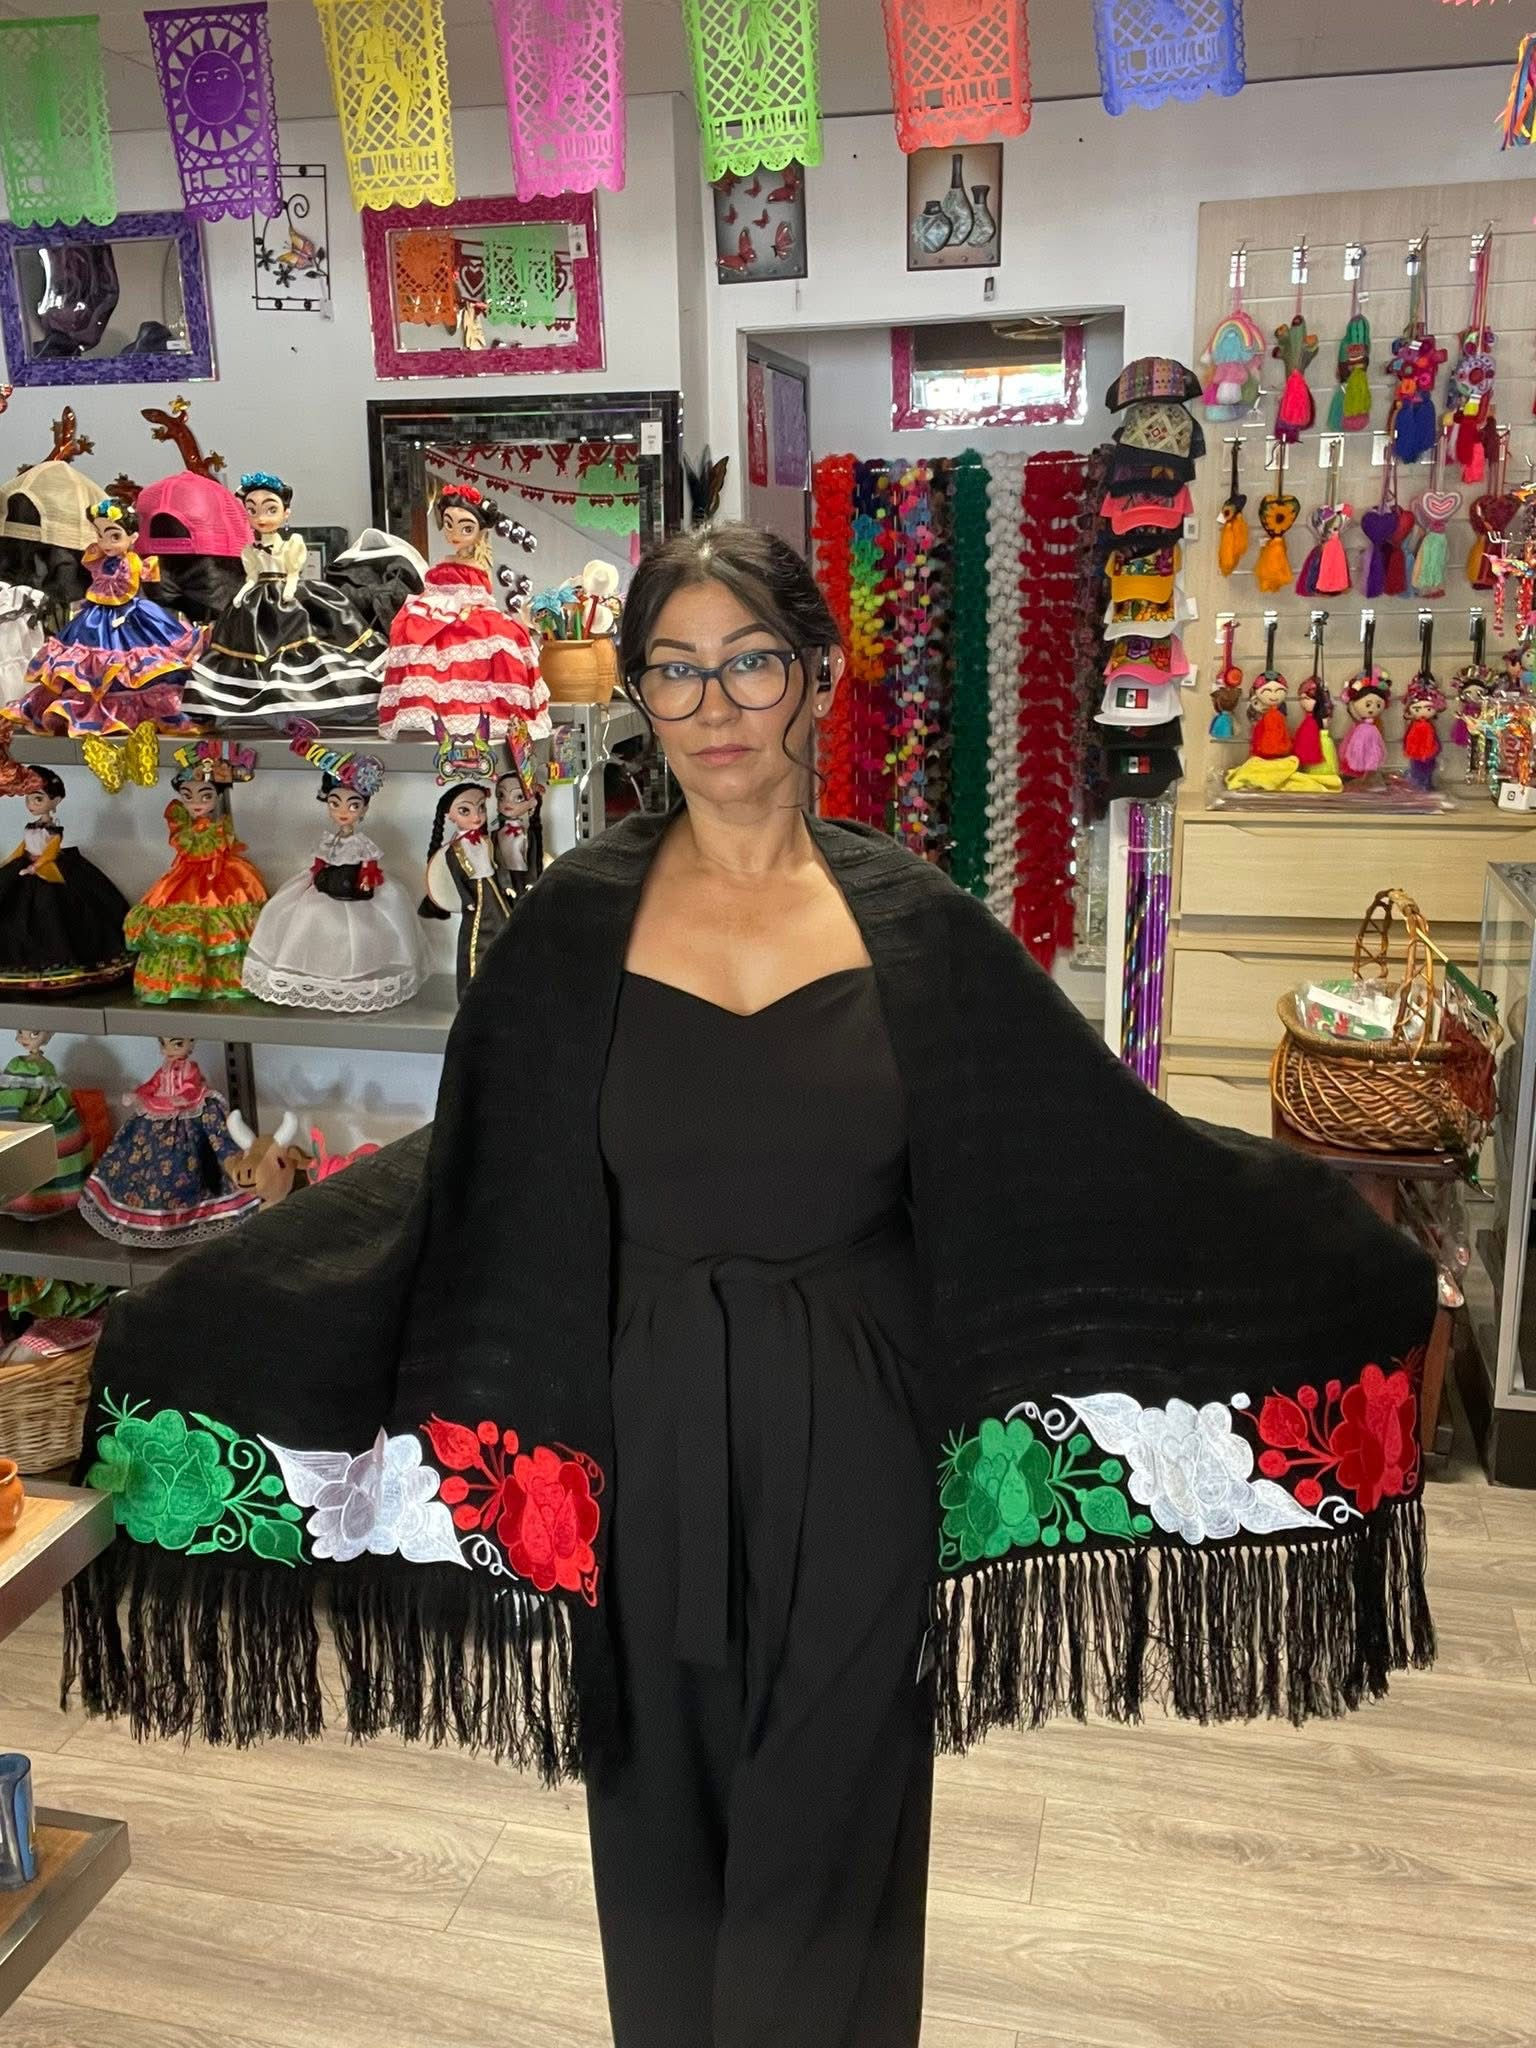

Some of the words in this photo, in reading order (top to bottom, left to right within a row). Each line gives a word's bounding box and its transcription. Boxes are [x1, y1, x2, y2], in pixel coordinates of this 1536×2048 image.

[944, 80, 998, 107] GALLO
[712, 118, 732, 143] EL
[742, 108, 806, 139] DIABLO
[190, 168, 212, 192] EL
[225, 163, 263, 191] SOL
[353, 156, 367, 178] EL
[371, 150, 440, 177] VALIENTE
[173, 739, 257, 770] TEQUILA
